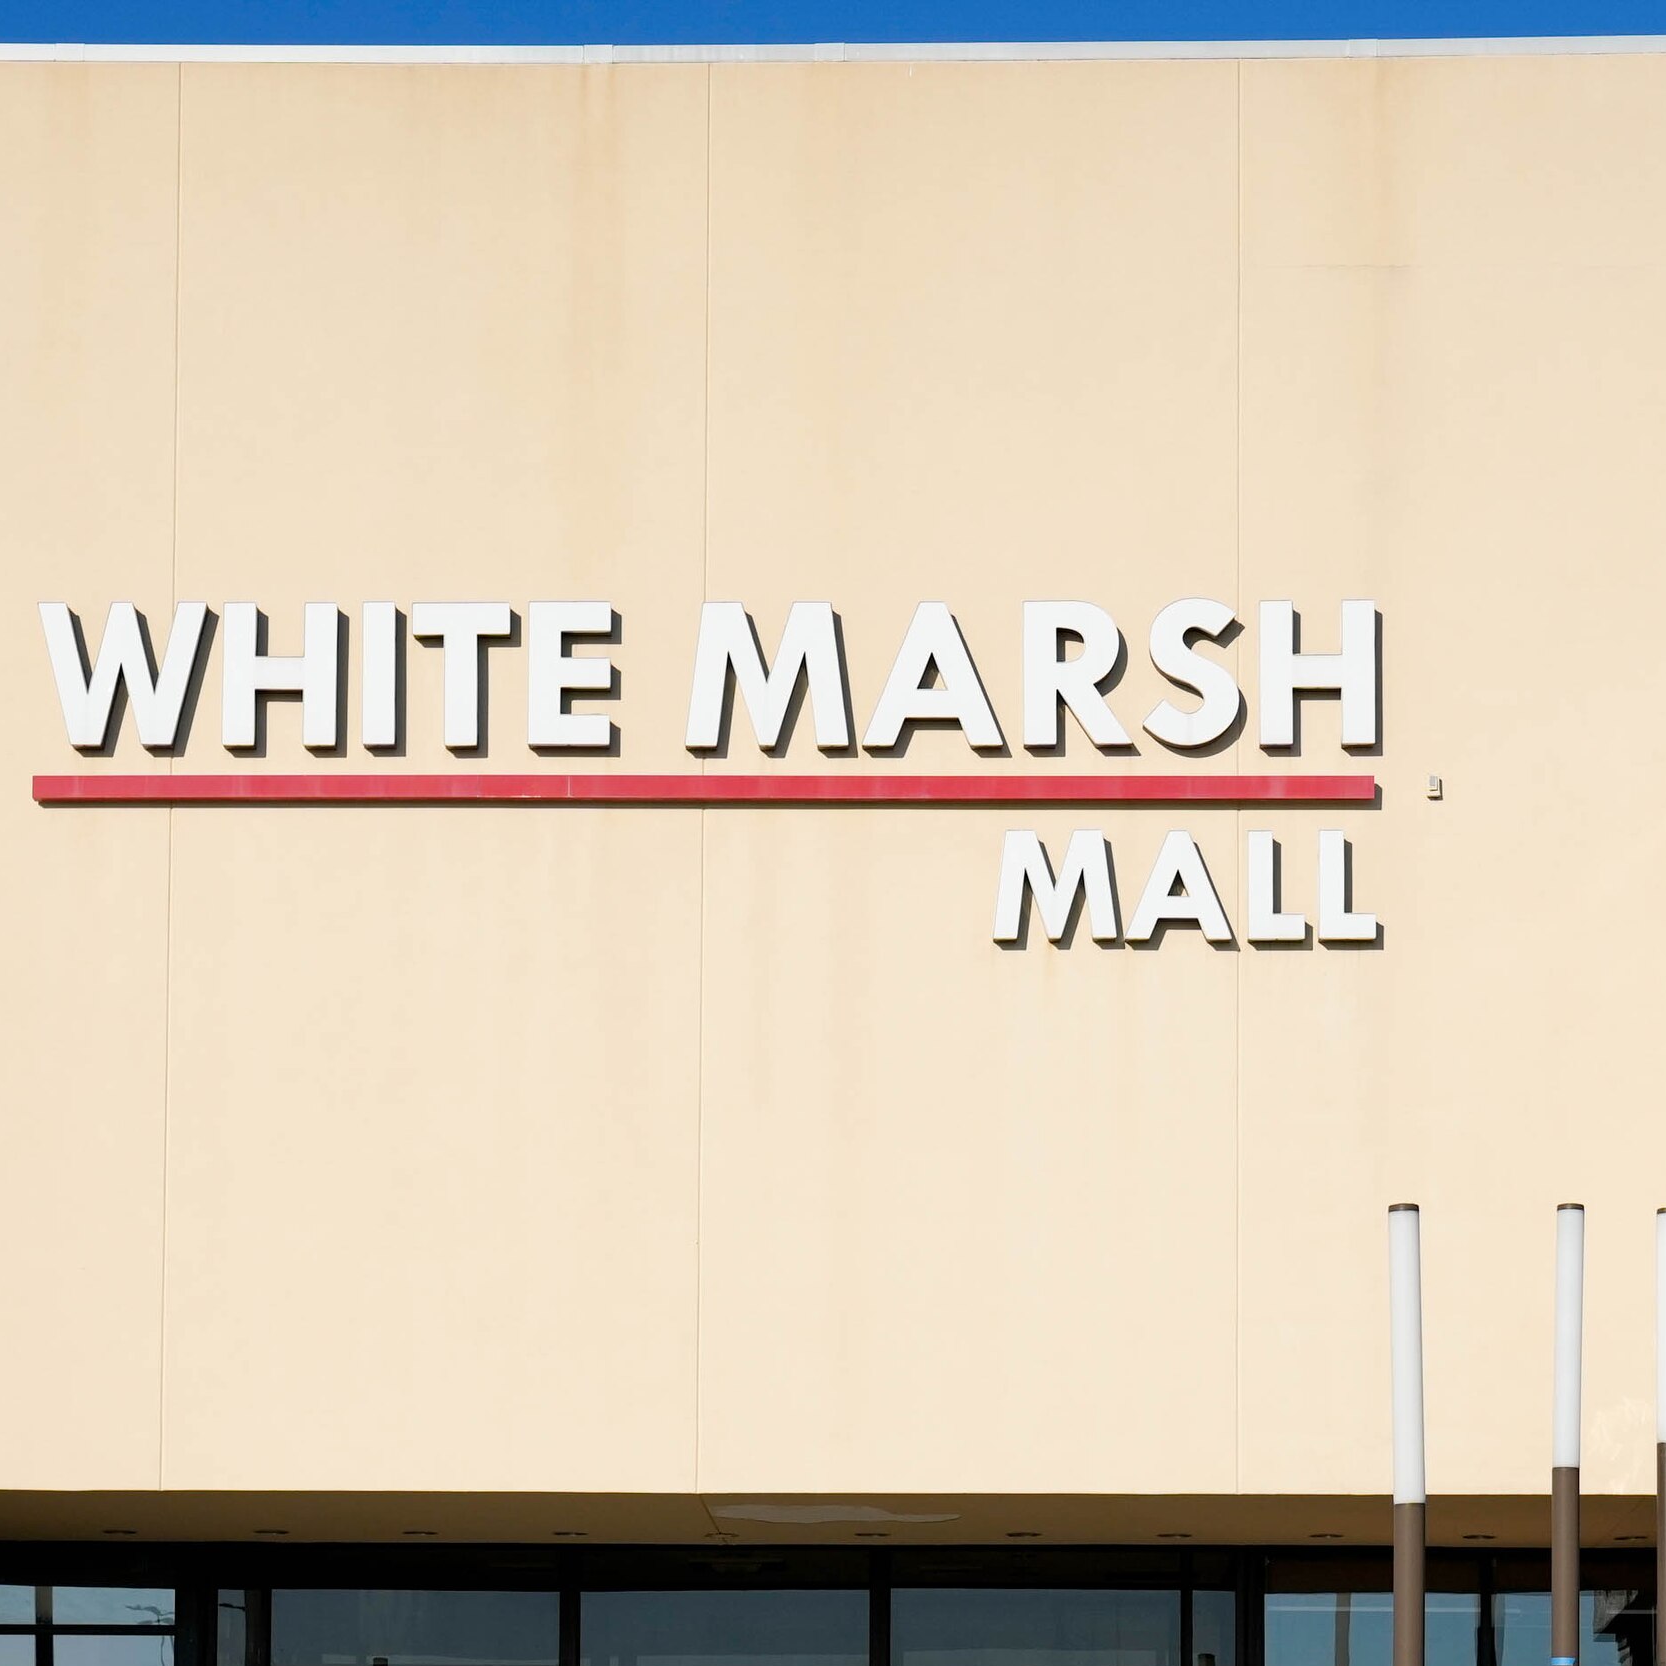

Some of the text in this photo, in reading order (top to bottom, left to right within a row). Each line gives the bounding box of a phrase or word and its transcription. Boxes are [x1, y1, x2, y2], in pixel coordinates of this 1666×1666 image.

[37, 597, 1379, 751] WHITE MARSH
[992, 828, 1377, 945] MALL
